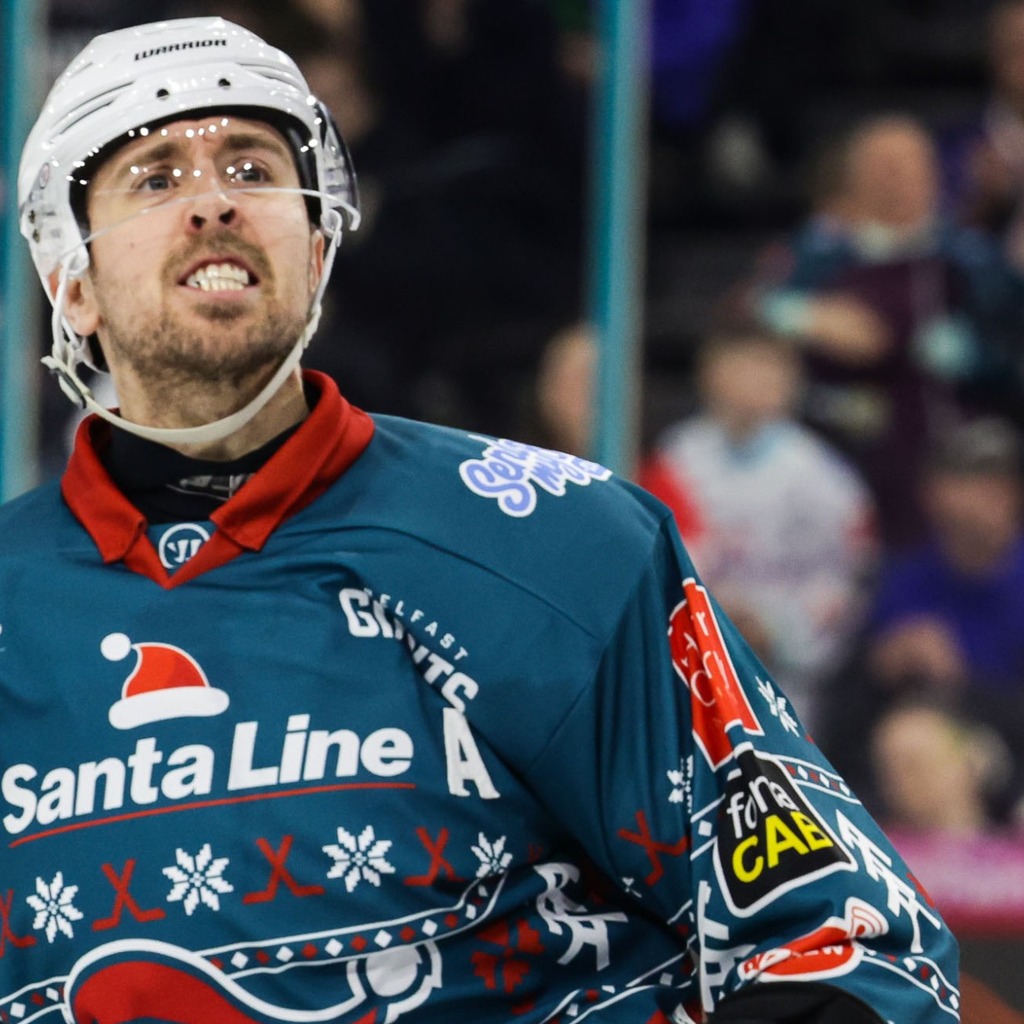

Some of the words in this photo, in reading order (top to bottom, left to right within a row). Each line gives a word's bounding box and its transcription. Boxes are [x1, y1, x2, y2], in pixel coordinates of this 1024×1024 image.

[133, 38, 228, 62] WARRIOR
[1, 737, 215, 834] Santa
[227, 713, 414, 791] Line
[443, 706, 501, 799] A
